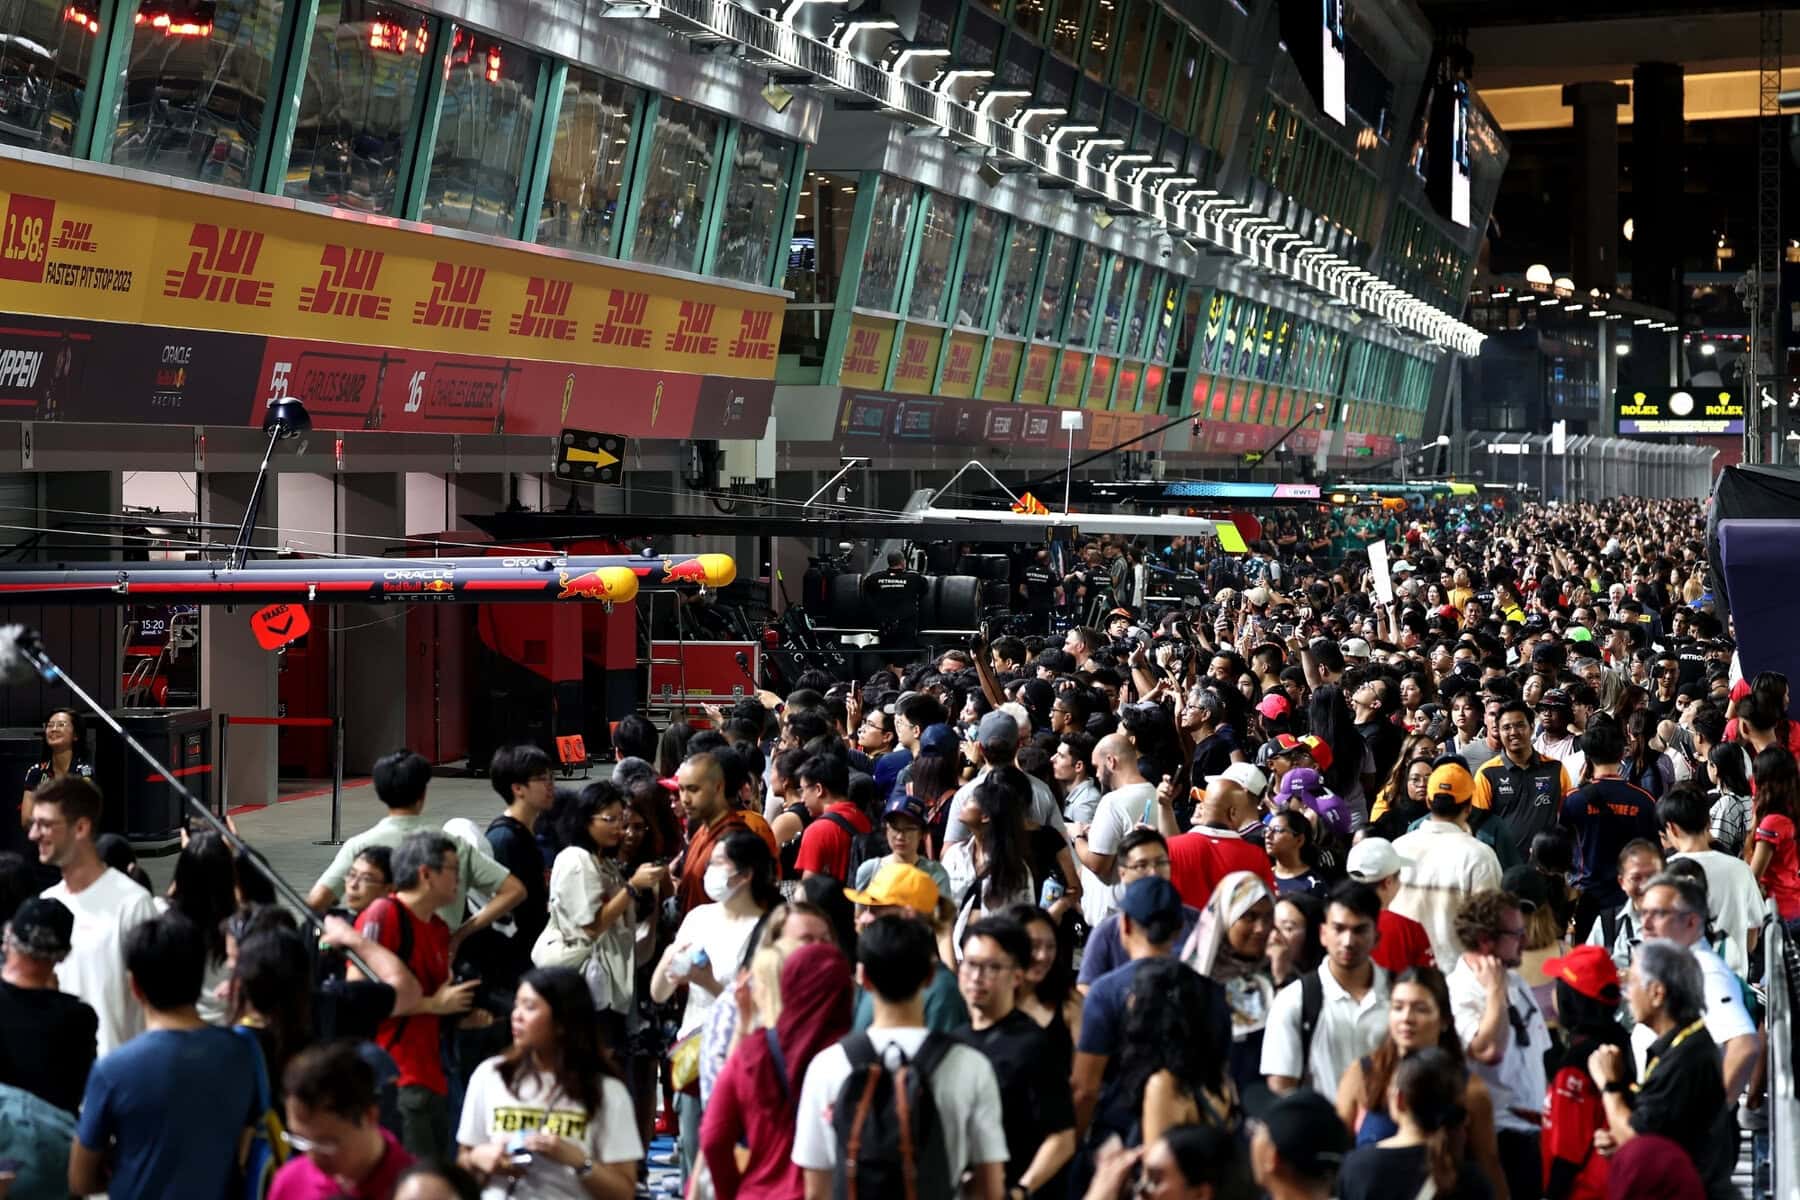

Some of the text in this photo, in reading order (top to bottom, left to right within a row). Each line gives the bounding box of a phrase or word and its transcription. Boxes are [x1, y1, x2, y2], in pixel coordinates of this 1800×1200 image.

[51, 220, 98, 252] DHL
[45, 262, 81, 286] FASTEST
[80, 265, 95, 288] PIT
[94, 267, 114, 290] STOP
[164, 223, 274, 307] DHL
[298, 244, 391, 320] DHL
[412, 261, 491, 332] DHL
[509, 276, 578, 341] DHL
[592, 288, 652, 348] DHL
[665, 300, 719, 354] DHL
[728, 309, 775, 360] DHL
[161, 345, 192, 364] ORACLE
[266, 362, 292, 408] 55
[404, 370, 426, 413] 16
[1621, 405, 1659, 415] ROLEX
[1705, 405, 1743, 415] ROLEX
[24, 431, 31, 459] 9
[384, 570, 454, 579] ORACLE
